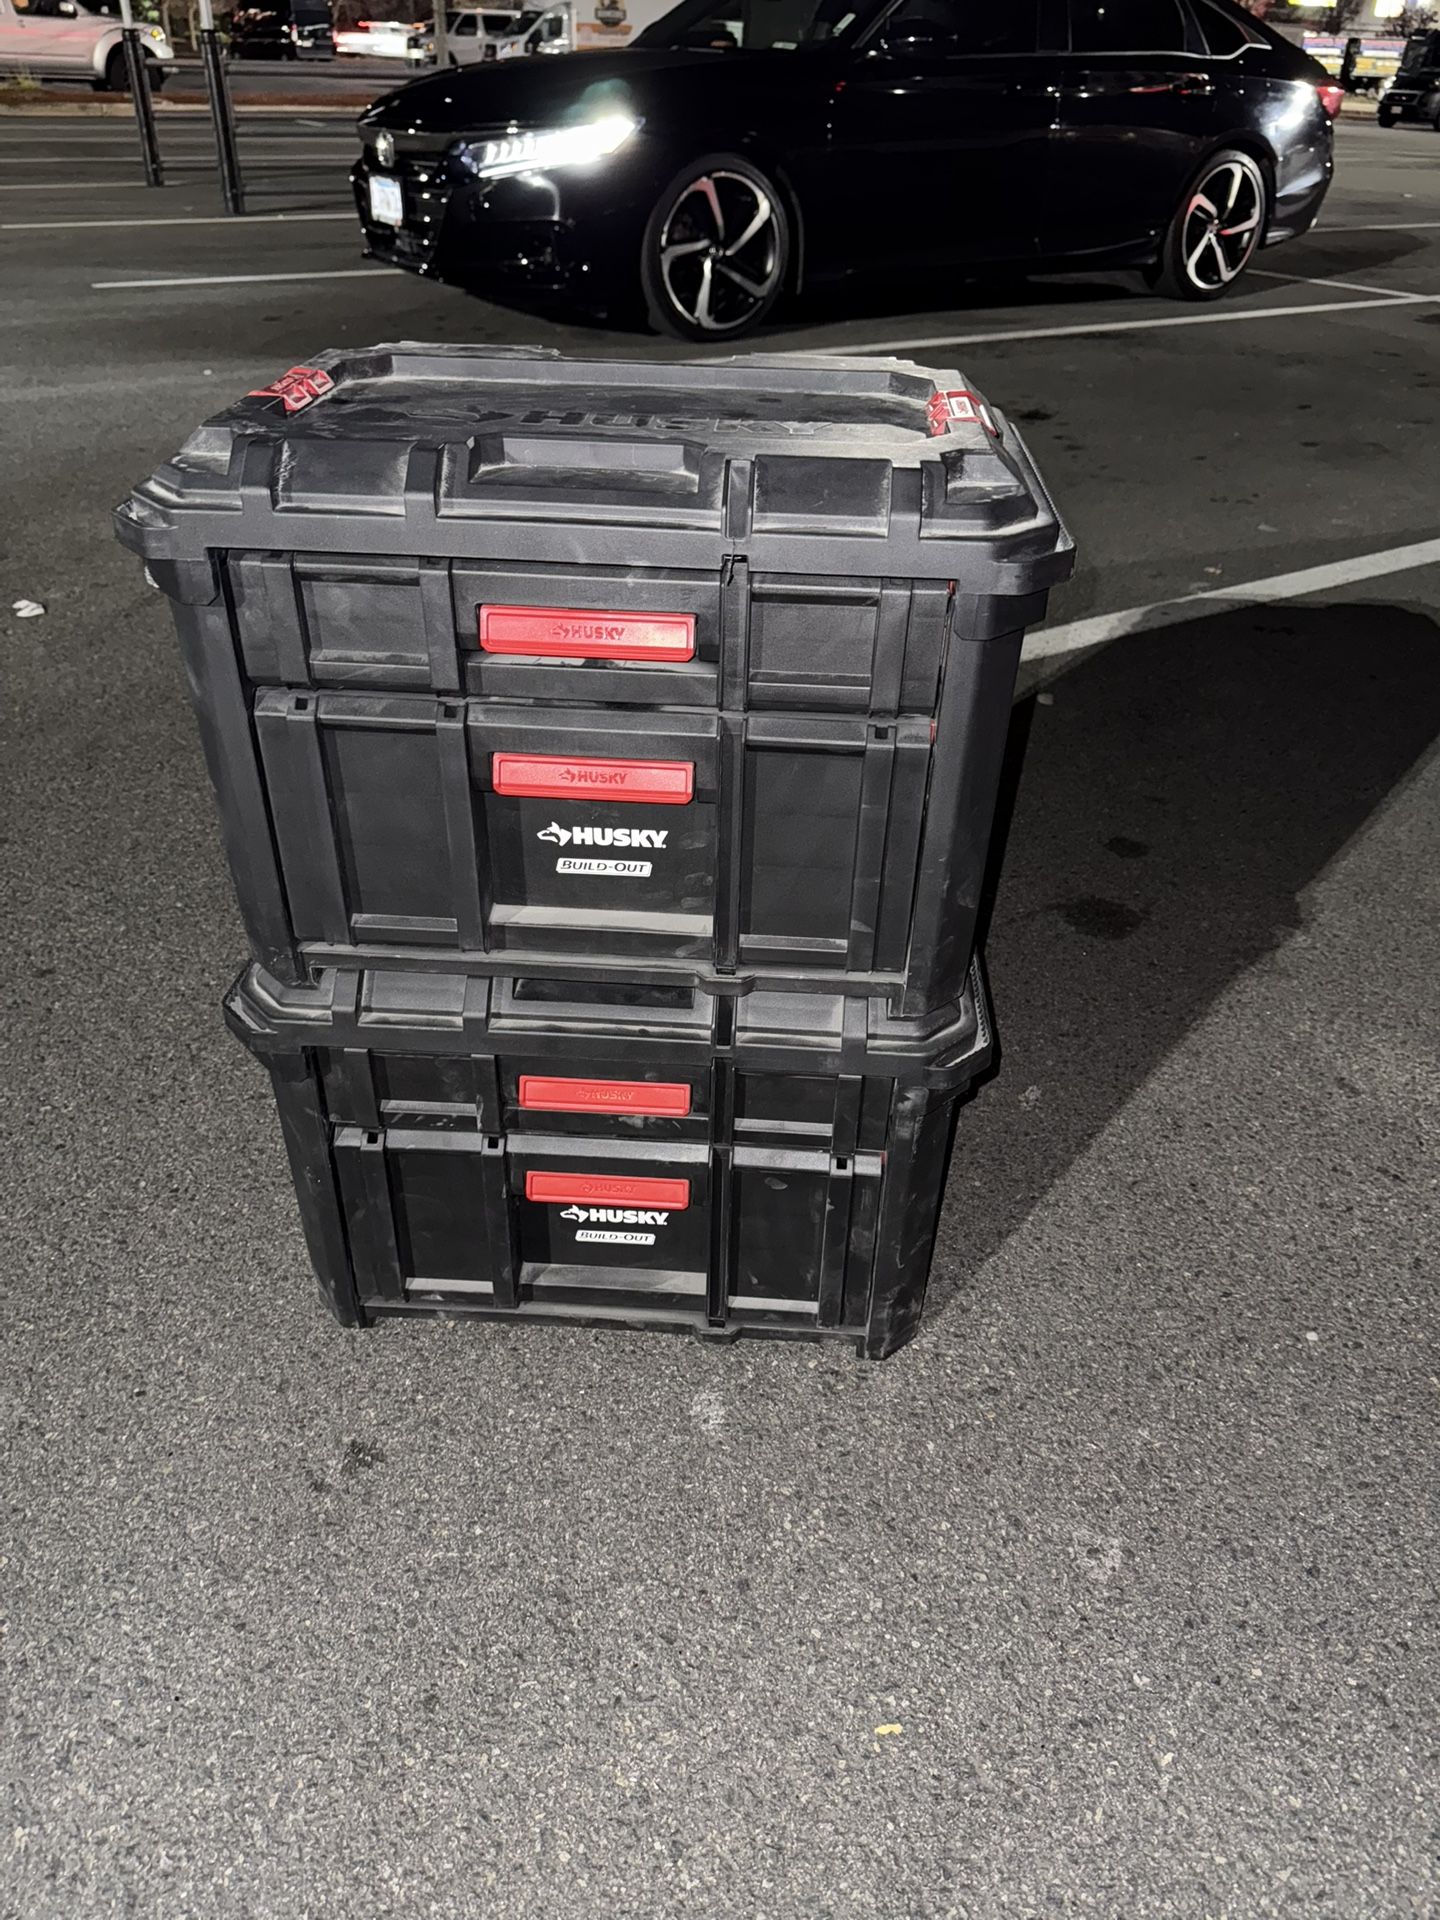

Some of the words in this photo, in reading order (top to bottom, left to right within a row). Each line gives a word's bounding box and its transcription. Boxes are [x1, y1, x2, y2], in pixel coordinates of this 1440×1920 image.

[520, 409, 832, 435] HUSKY
[571, 625, 626, 641] HUSKY
[577, 770, 629, 785] HUSKY
[560, 860, 648, 873] BUILD-OUT
[591, 1089, 635, 1101] HUSKY
[595, 1182, 636, 1194] HUSKY
